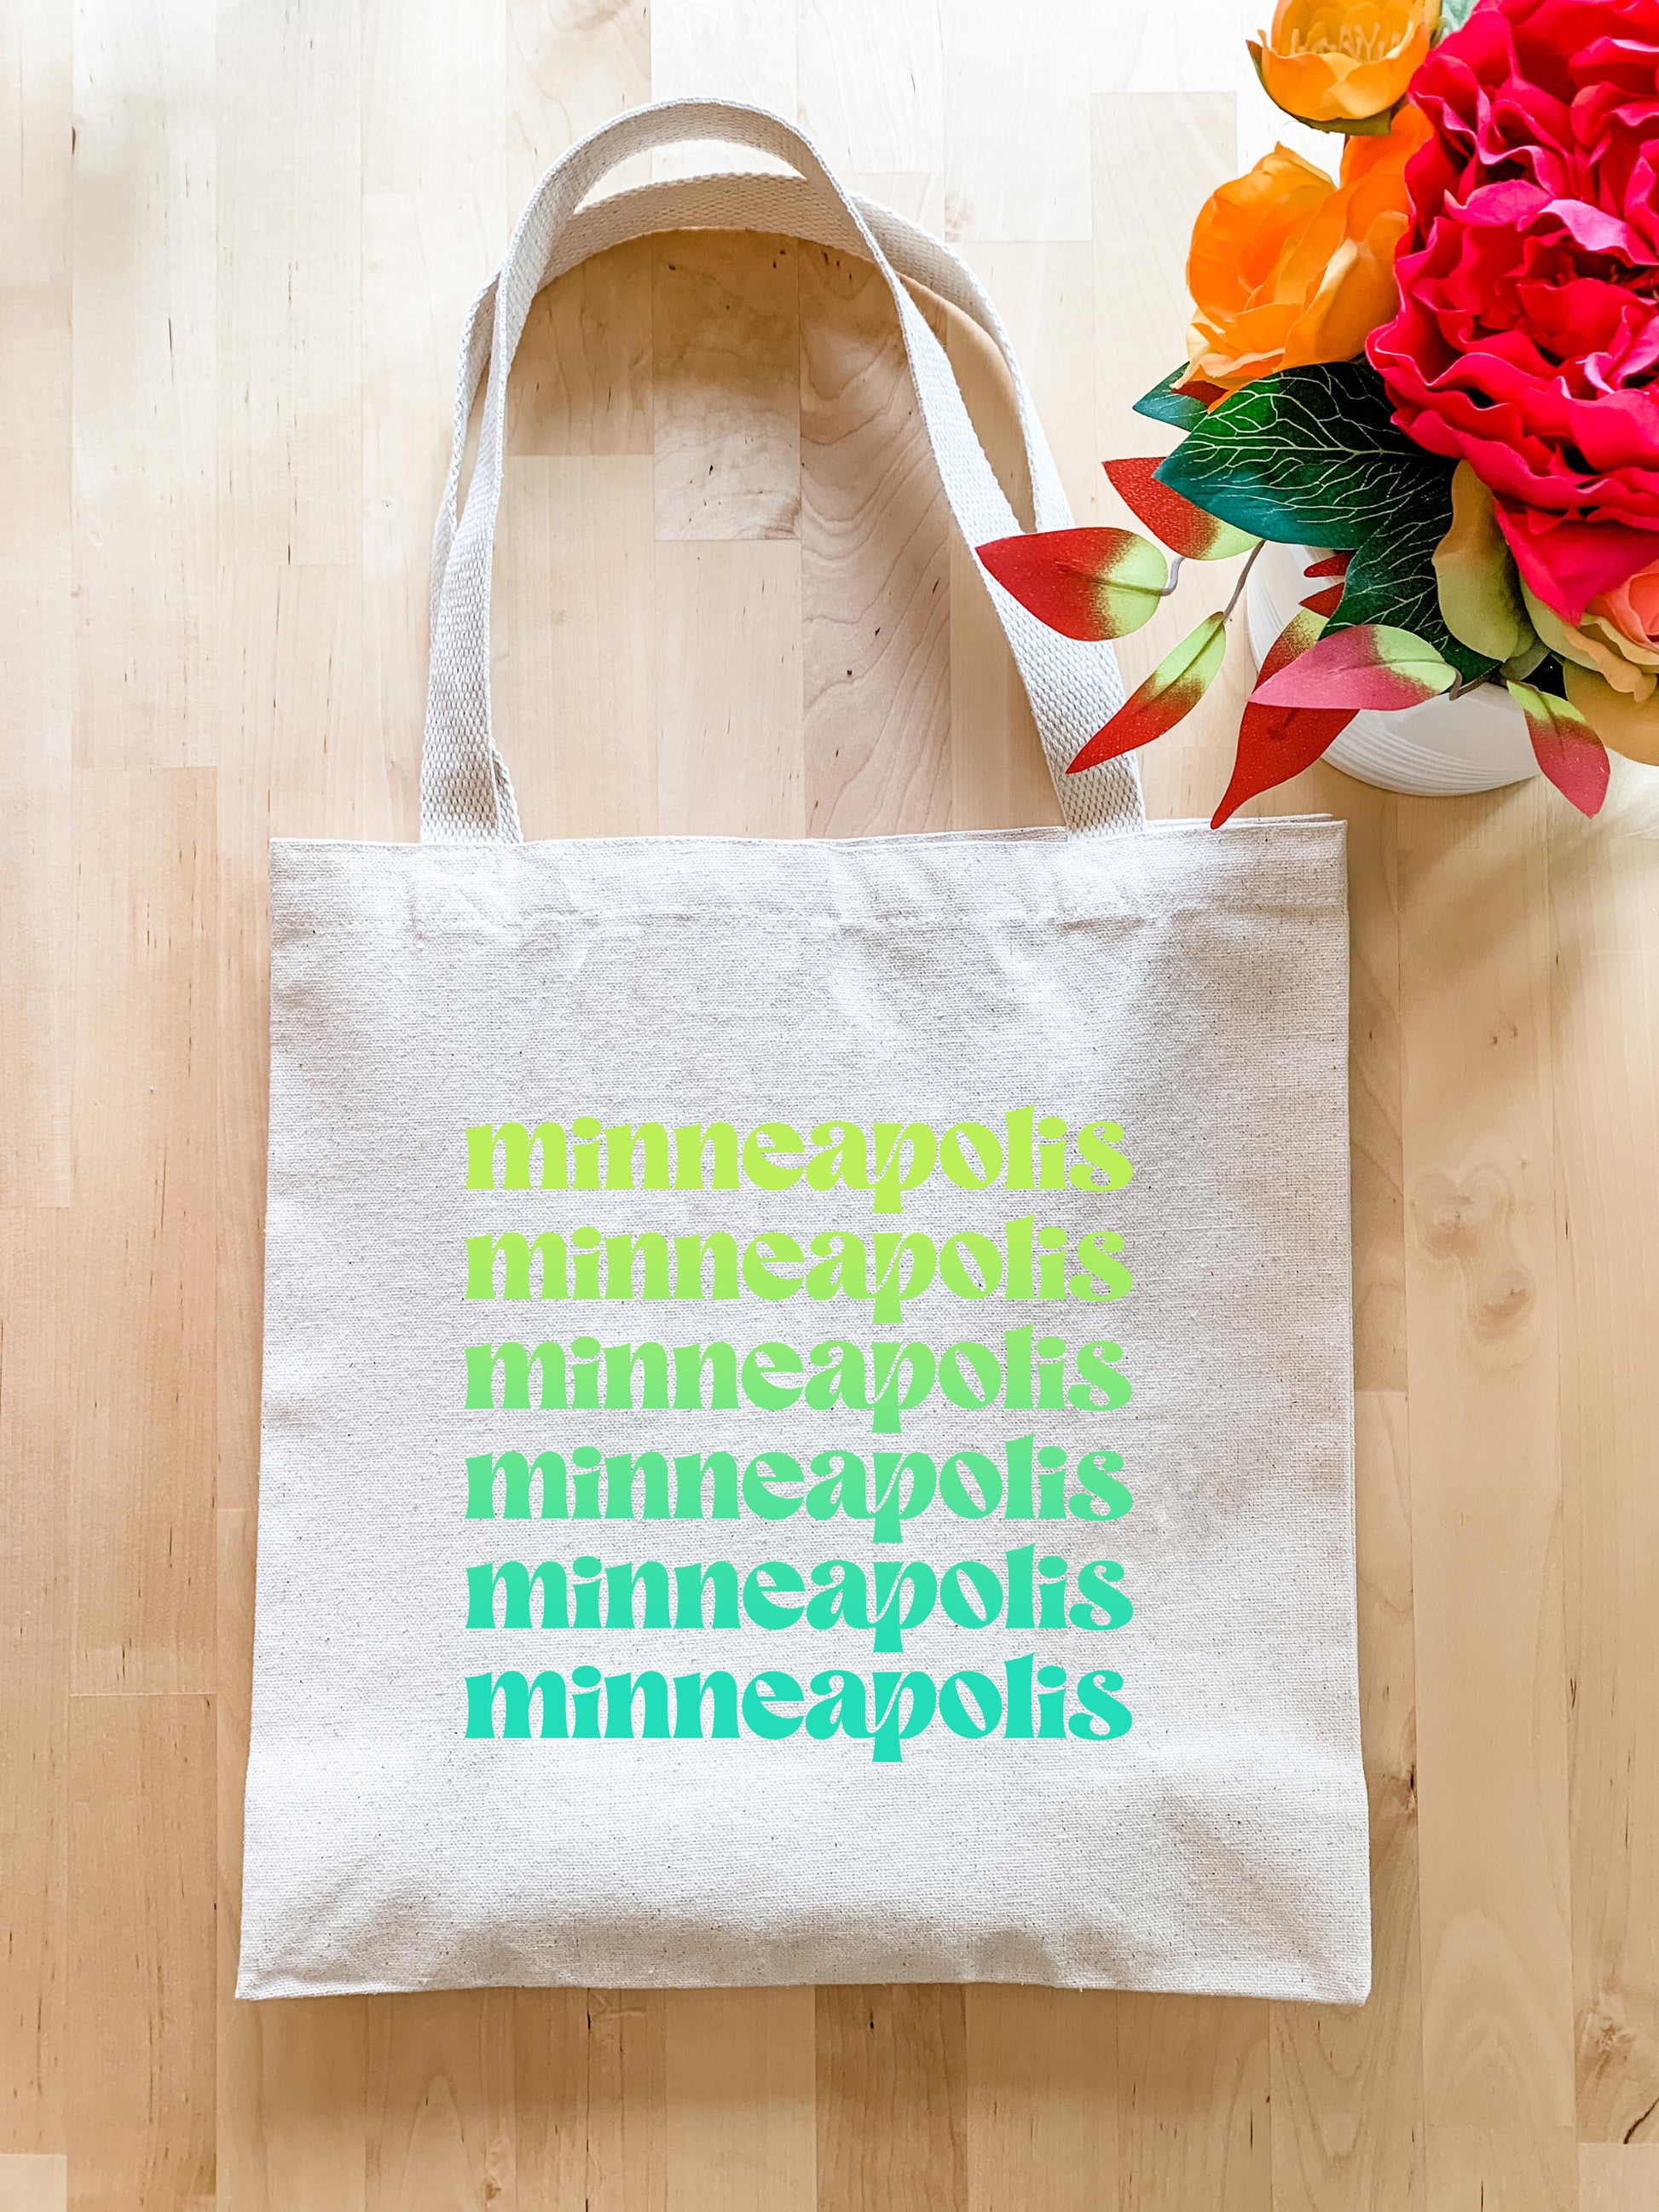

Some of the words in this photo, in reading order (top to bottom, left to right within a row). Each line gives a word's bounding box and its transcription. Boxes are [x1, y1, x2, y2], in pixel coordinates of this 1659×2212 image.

[465, 1103, 1134, 1214] minneapolis
[465, 1213, 1134, 1324] minneapolis
[464, 1323, 1132, 1433] minneapolis
[465, 1433, 1134, 1544] minneapolis
[465, 1543, 1135, 1653] minneapolis
[464, 1652, 1133, 1763] minneapolis
